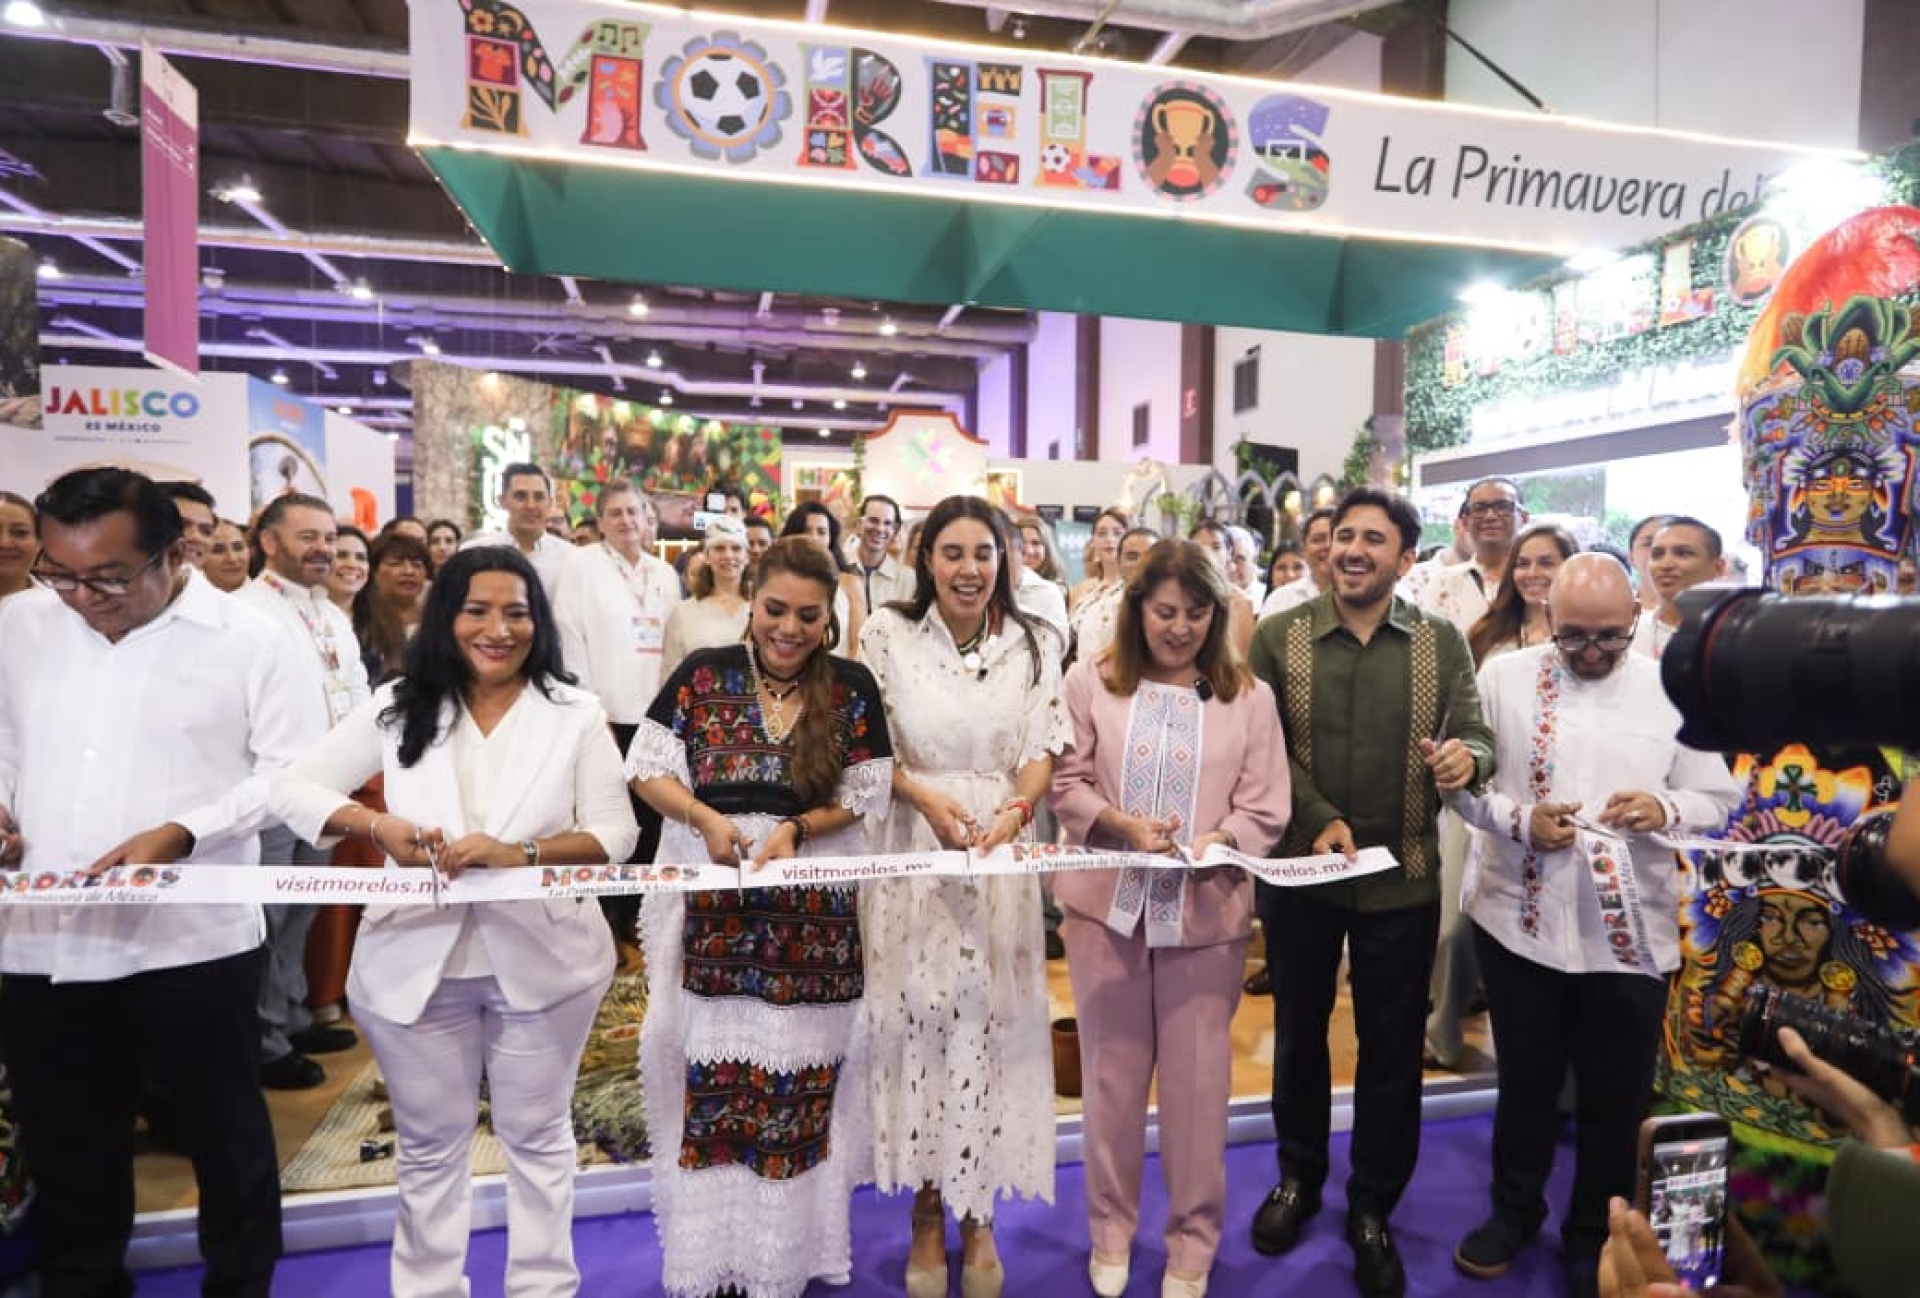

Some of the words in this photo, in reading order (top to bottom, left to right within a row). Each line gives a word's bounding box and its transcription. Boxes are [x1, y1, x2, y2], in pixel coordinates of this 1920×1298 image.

[457, 0, 1332, 213] MORELOS
[1374, 136, 1435, 196] La
[1452, 145, 1686, 219] Primavera
[46, 386, 199, 419] JALISCO
[105, 420, 161, 433] MÉXICO
[541, 865, 701, 887] MORELOS
